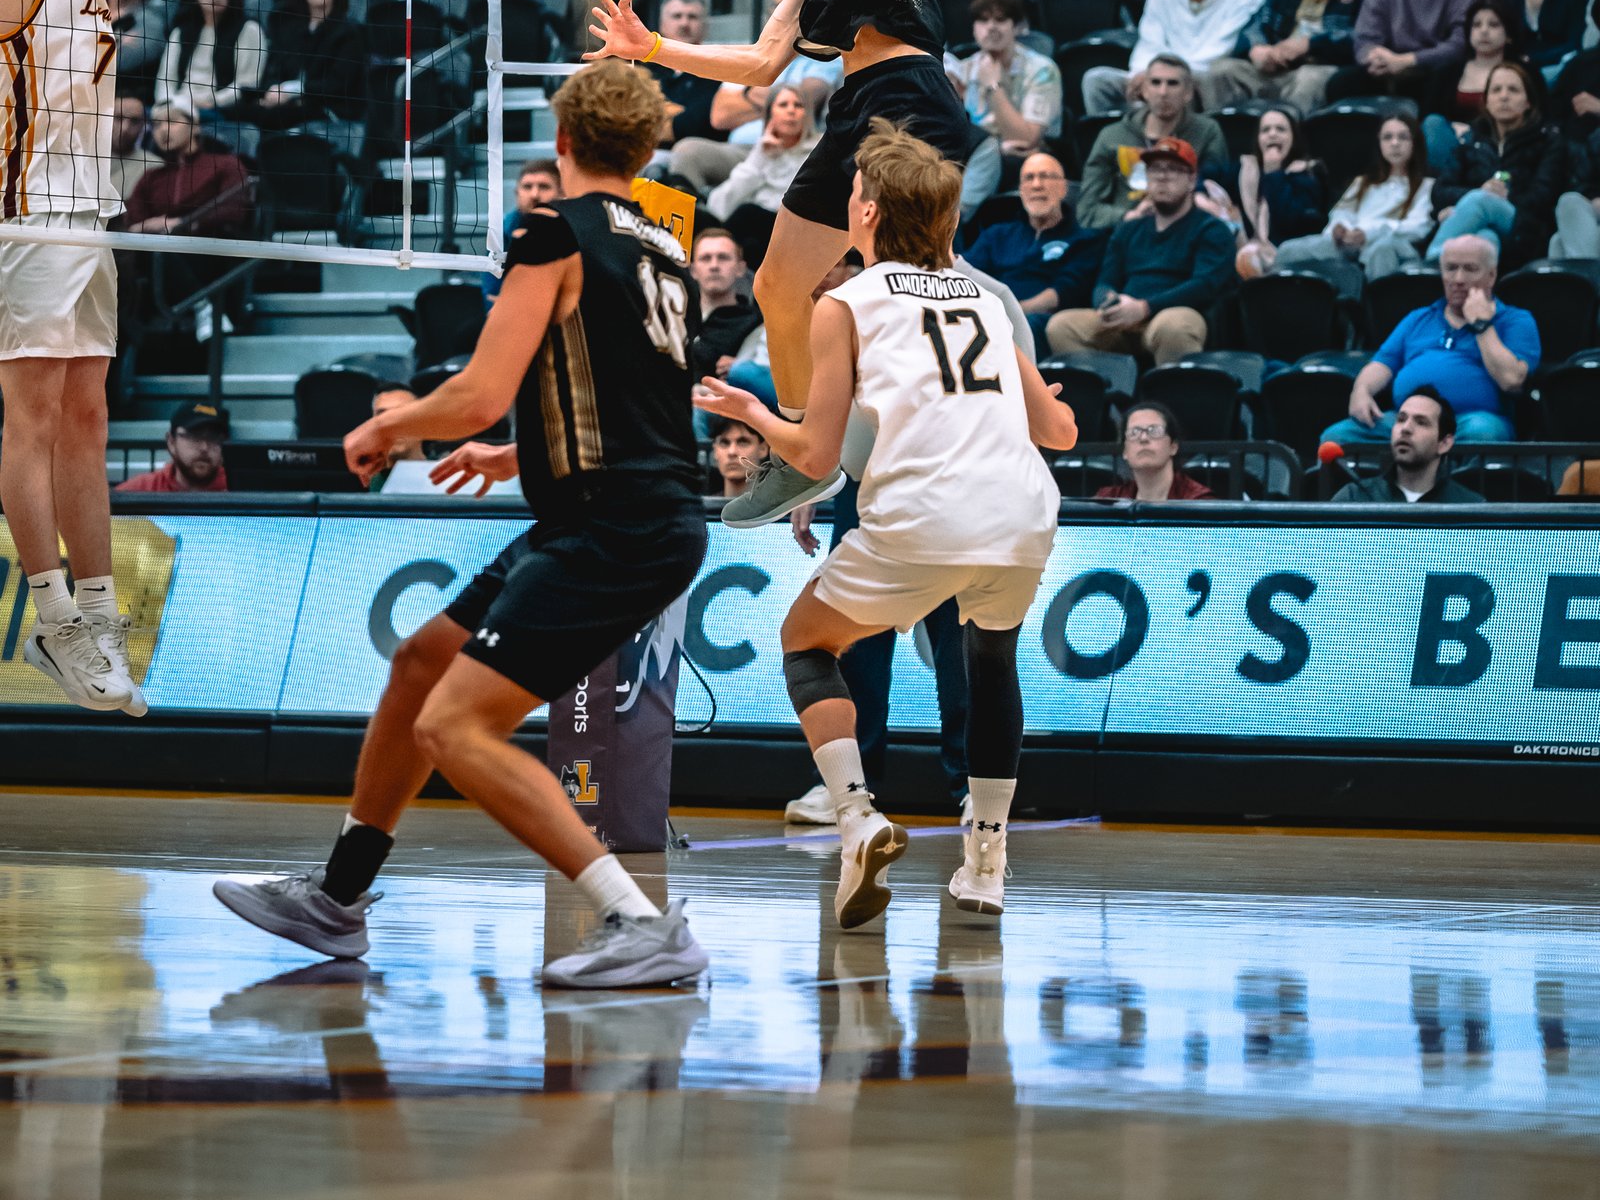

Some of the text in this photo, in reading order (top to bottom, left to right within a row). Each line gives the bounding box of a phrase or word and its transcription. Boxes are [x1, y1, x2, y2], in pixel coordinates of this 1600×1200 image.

[92, 32, 117, 85] 7
[885, 272, 981, 300] LINDENWOOD
[922, 307, 1003, 395] 12
[1409, 572, 1600, 689] BE
[1513, 745, 1600, 757] DAKTRONICS
